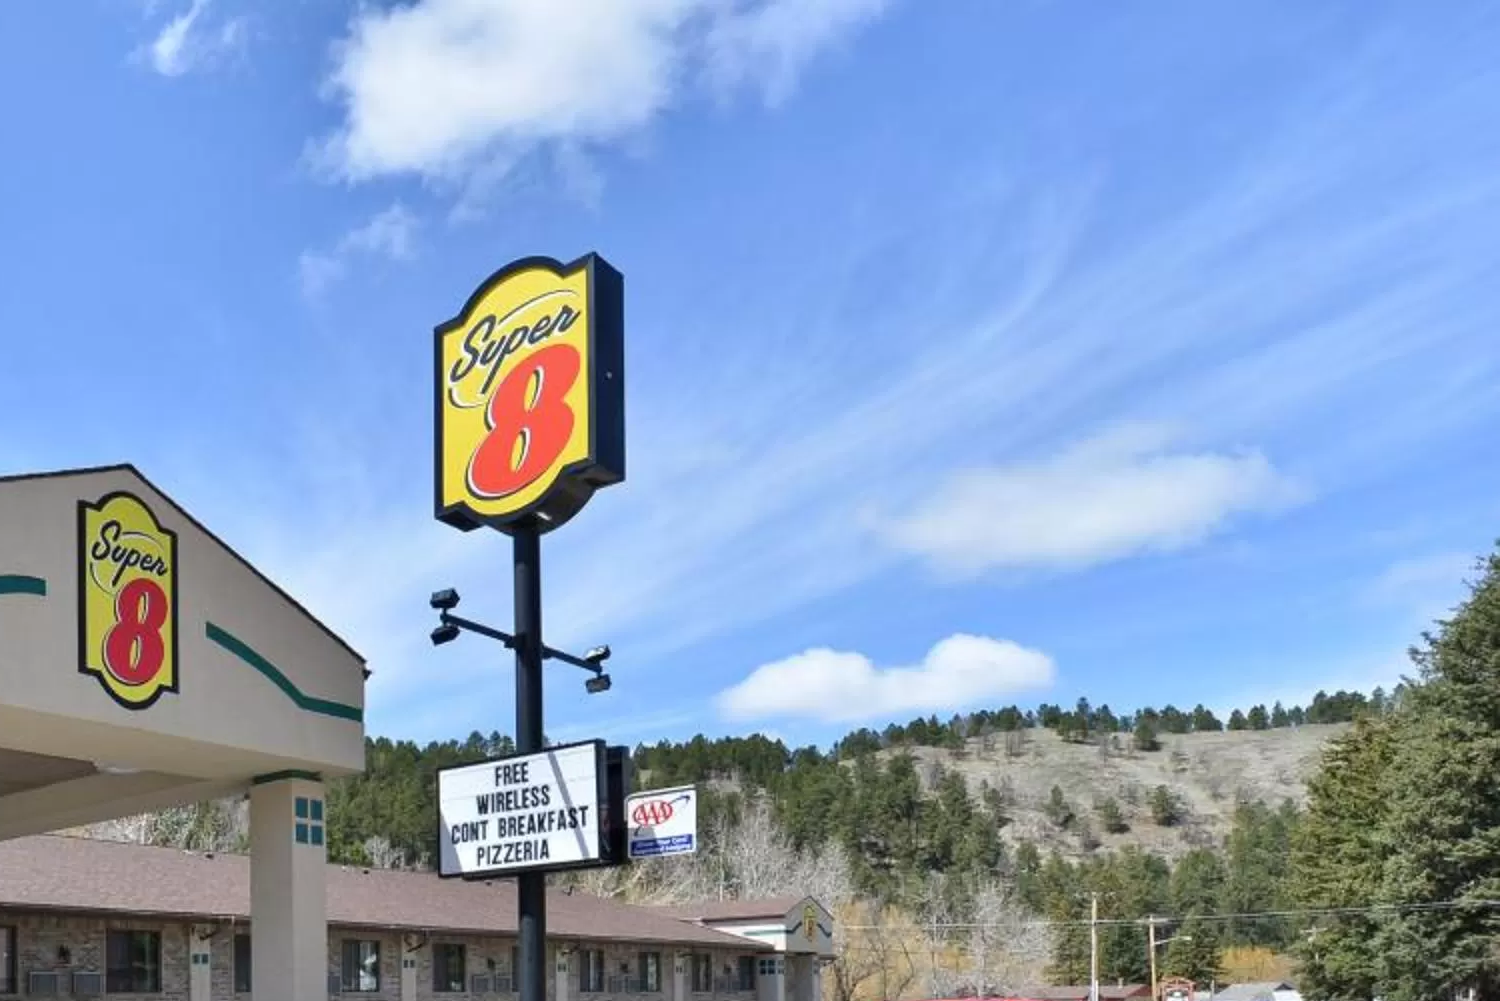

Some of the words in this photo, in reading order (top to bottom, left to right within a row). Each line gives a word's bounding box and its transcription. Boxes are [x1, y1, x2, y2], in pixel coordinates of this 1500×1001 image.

[450, 304, 580, 395] Super
[465, 343, 581, 500] 8
[91, 520, 167, 586] Super
[102, 577, 168, 686] 8
[495, 762, 529, 786] FREE
[476, 785, 550, 815] WIRELESS
[632, 801, 673, 827] AAA
[451, 820, 488, 845] CONT
[498, 806, 589, 838] BREAKFAST
[477, 839, 549, 867] PIZZERIA
